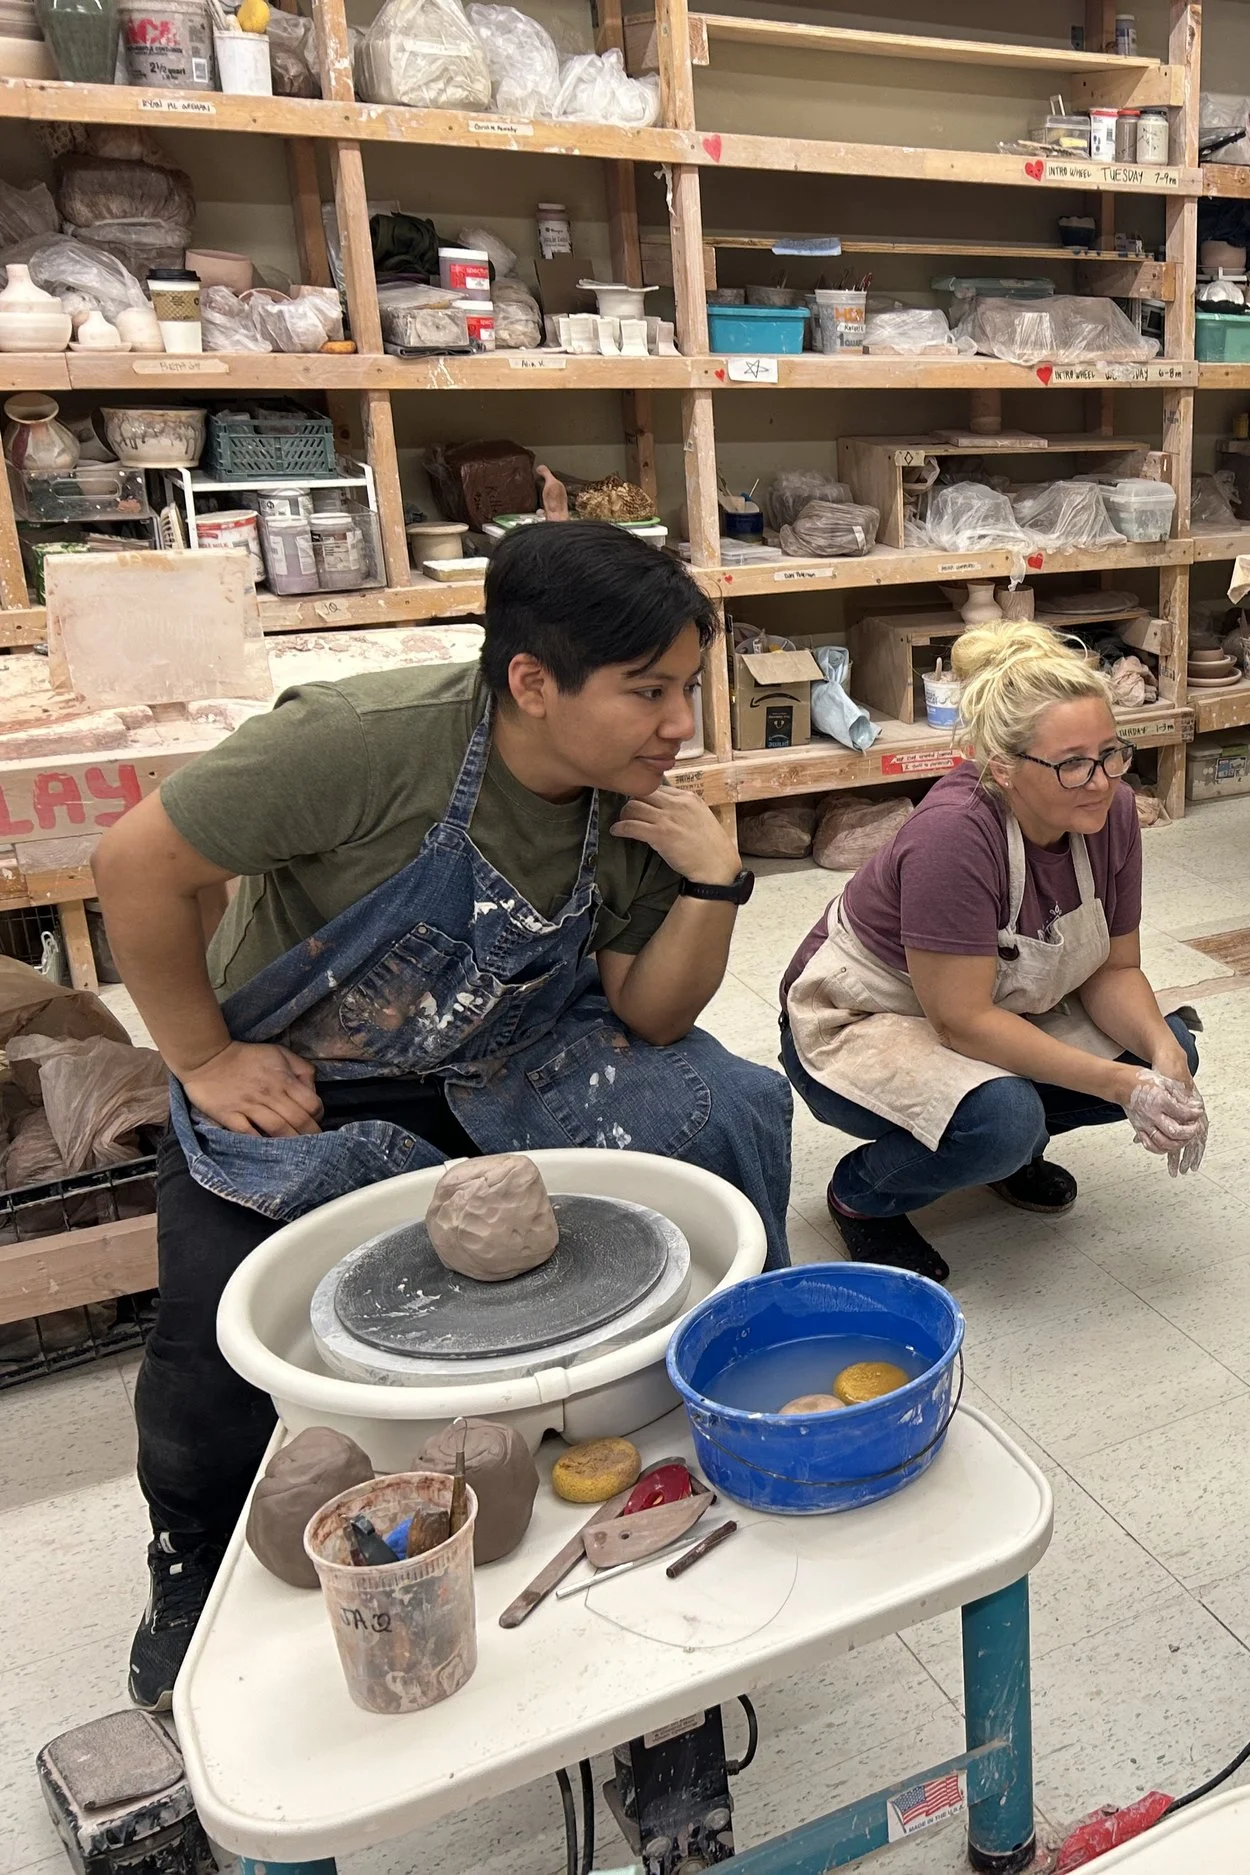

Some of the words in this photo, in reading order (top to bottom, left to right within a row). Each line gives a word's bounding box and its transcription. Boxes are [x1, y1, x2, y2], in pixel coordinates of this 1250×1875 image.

[1048, 167, 1068, 177] INTRO
[1101, 166, 1144, 183] TUESDAY
[1055, 370, 1074, 380] INTRO
[0, 764, 143, 837] LAY
[908, 1820, 926, 1833] MADE
[935, 1812, 947, 1822] THE
